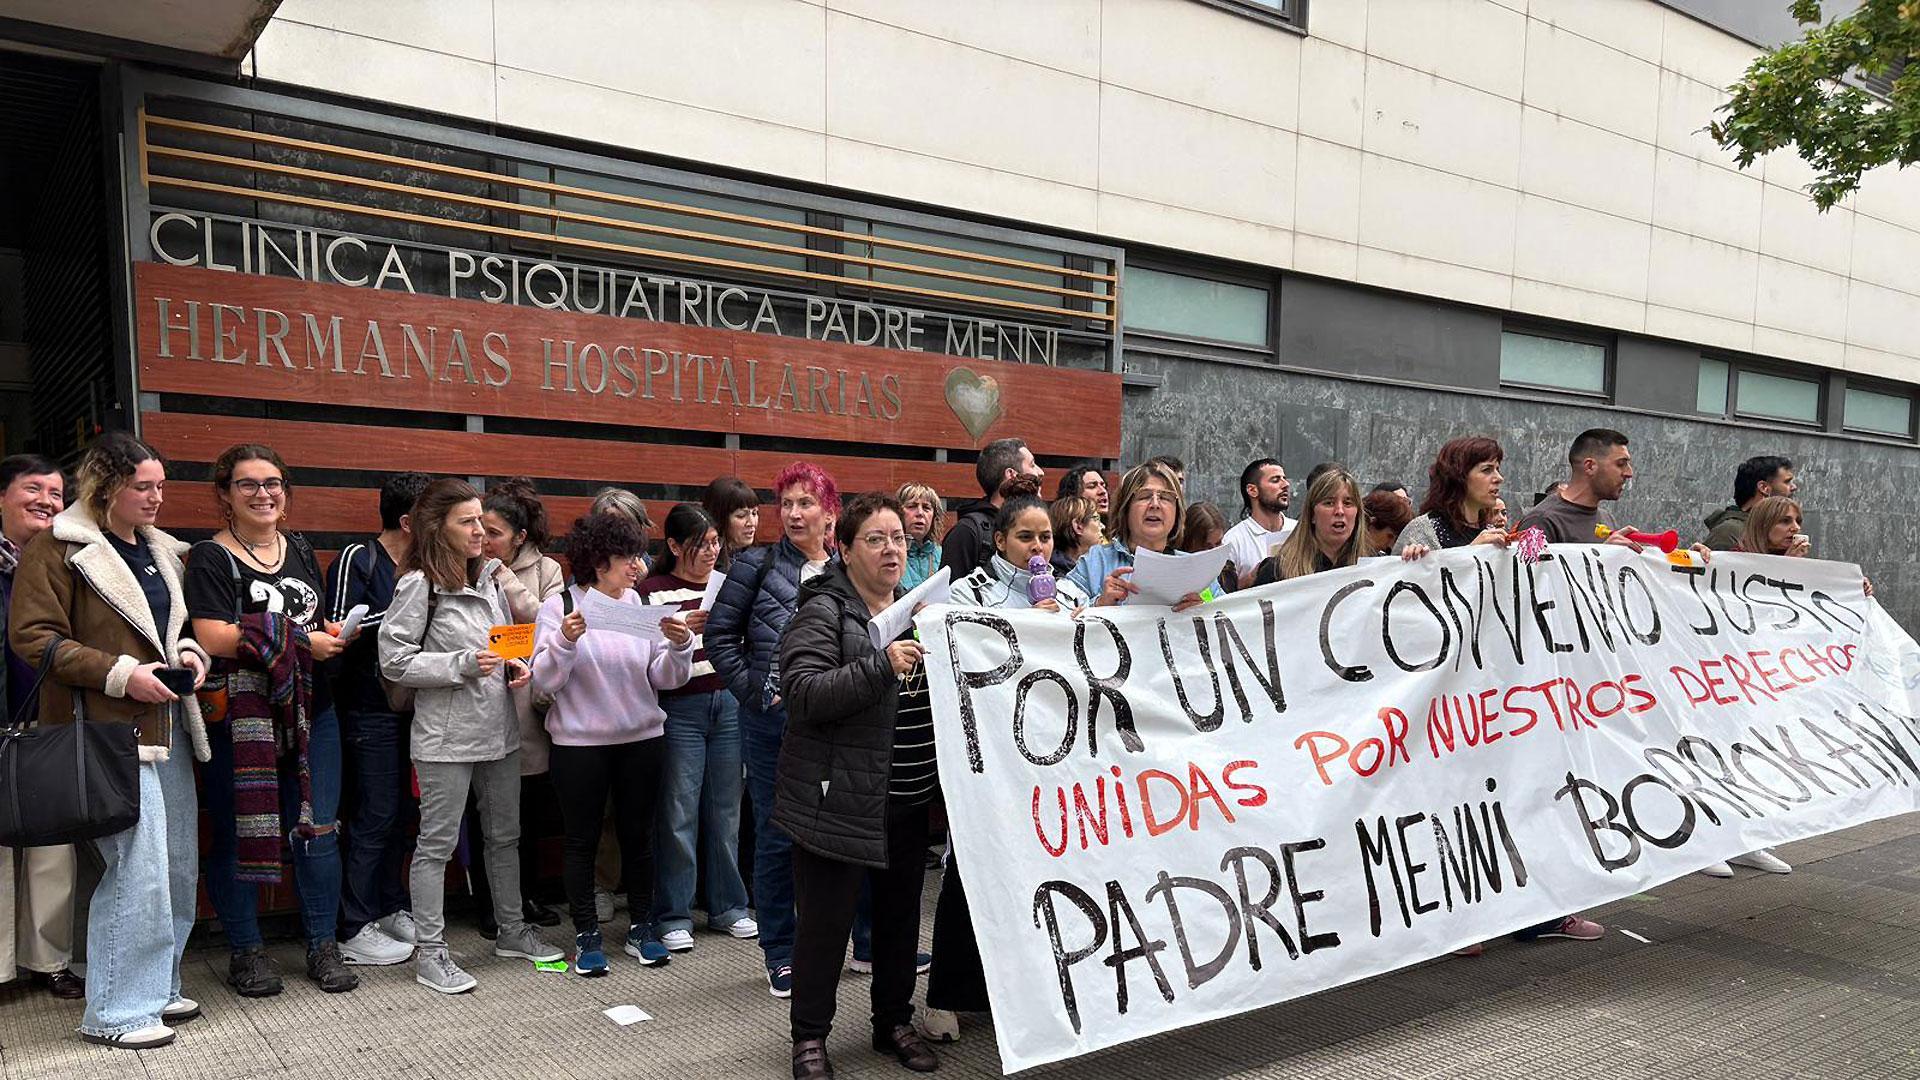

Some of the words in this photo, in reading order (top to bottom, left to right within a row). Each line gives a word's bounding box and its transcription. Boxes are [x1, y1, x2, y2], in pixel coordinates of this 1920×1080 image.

[150, 212, 416, 295] CLINICA
[449, 251, 781, 337] PSIQUIATRICA
[806, 297, 925, 353] PADRE
[945, 317, 1058, 368] MENNI
[154, 297, 512, 388] HERMANAS
[540, 337, 900, 421] HOSPITALARIAS
[1157, 599, 1287, 733] UN
[1671, 565, 1865, 636] JUSTO
[1427, 674, 1657, 759] NUESTROS
[1033, 838, 1341, 1035] PADRE
